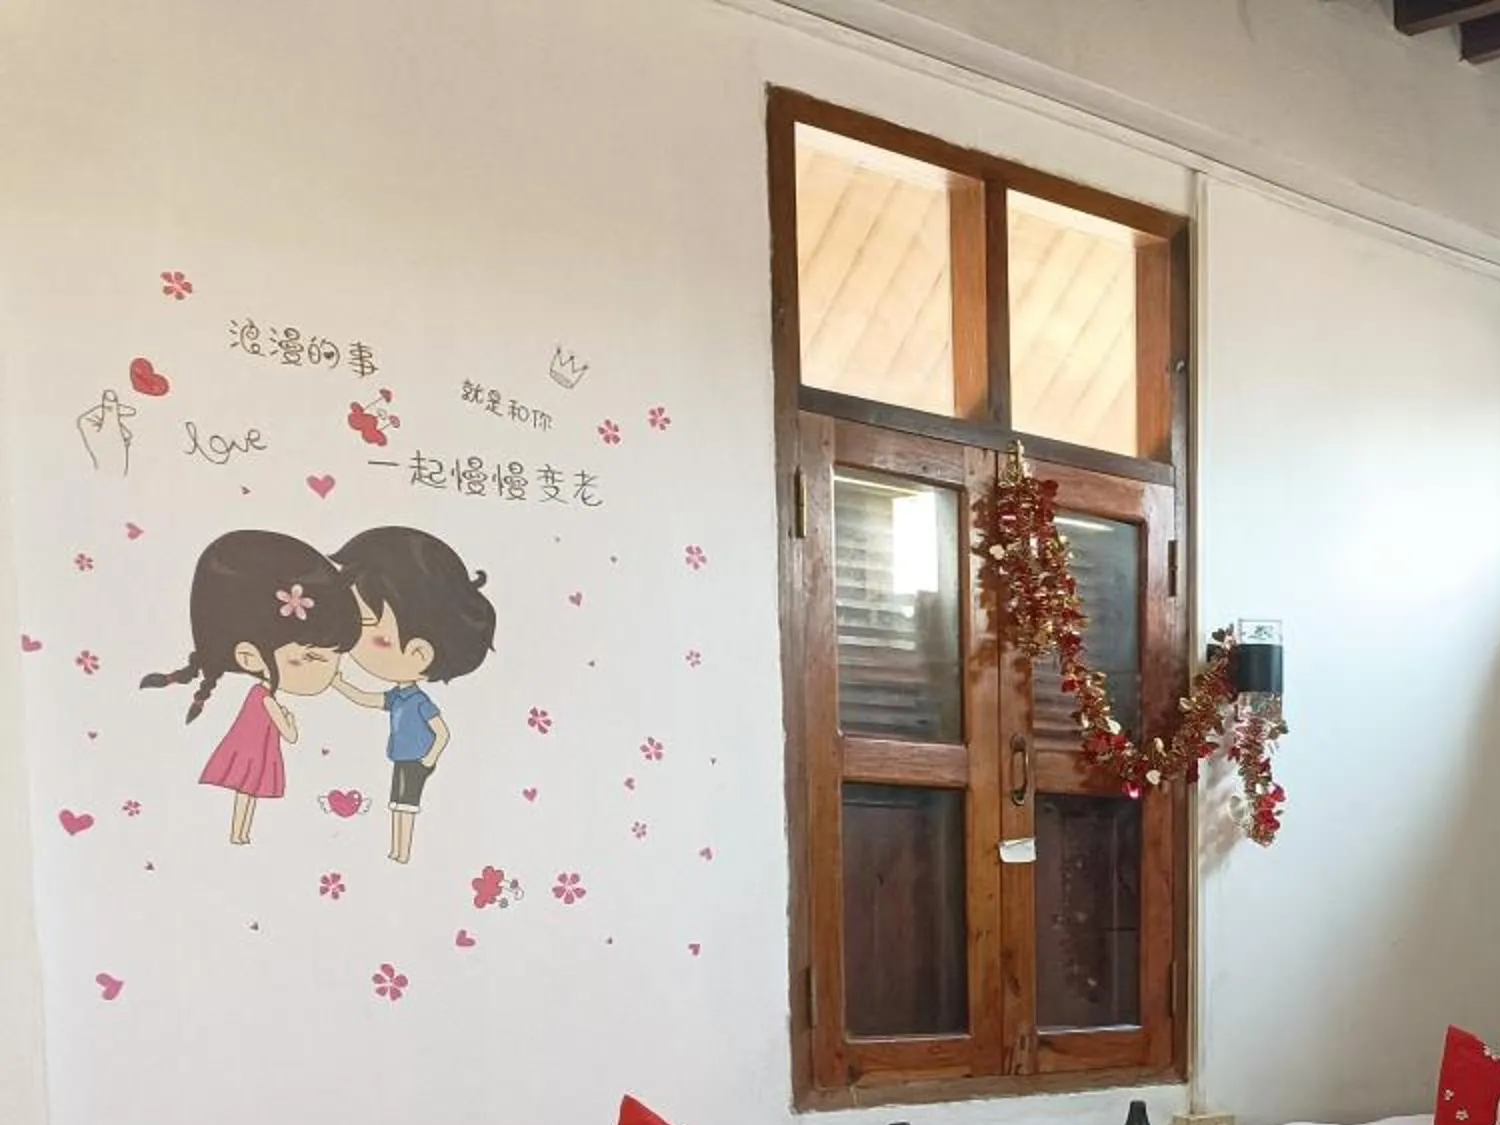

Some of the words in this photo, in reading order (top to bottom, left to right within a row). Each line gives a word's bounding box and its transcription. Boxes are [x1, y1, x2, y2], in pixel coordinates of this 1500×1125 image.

[228, 317, 379, 378] 浪漫的事
[460, 379, 553, 431] 就是和你
[184, 420, 268, 465] love
[367, 449, 604, 507] 一起慢慢变老
